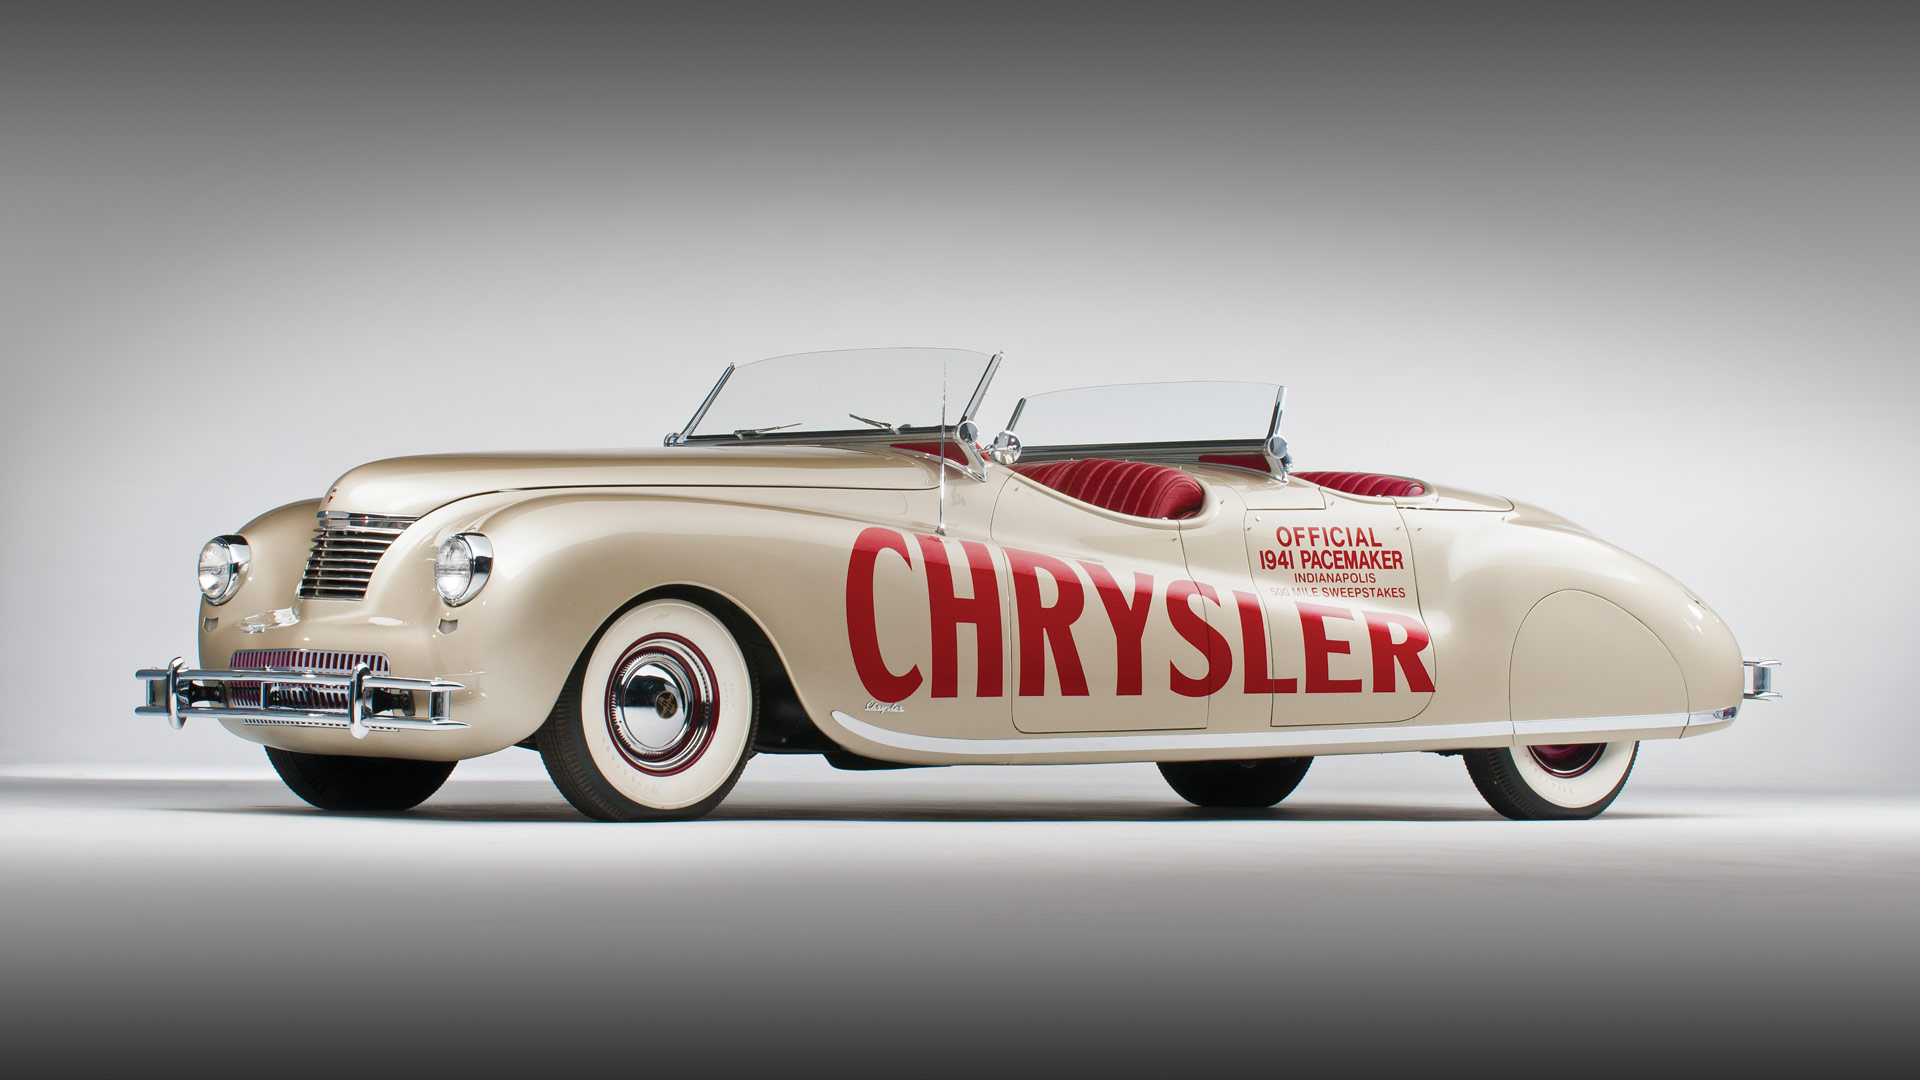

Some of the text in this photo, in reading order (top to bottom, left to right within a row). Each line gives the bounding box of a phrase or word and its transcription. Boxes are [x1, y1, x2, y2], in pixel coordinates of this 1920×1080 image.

[1276, 526, 1383, 548] OFFICIAL
[1259, 550, 1404, 570] 1941 PACEMAKER
[1294, 572, 1377, 584] INDIANAPOLIS
[1270, 587, 1406, 599] 500 MILE SWEEPSTAKES
[846, 526, 1436, 703] CHRYSLER
